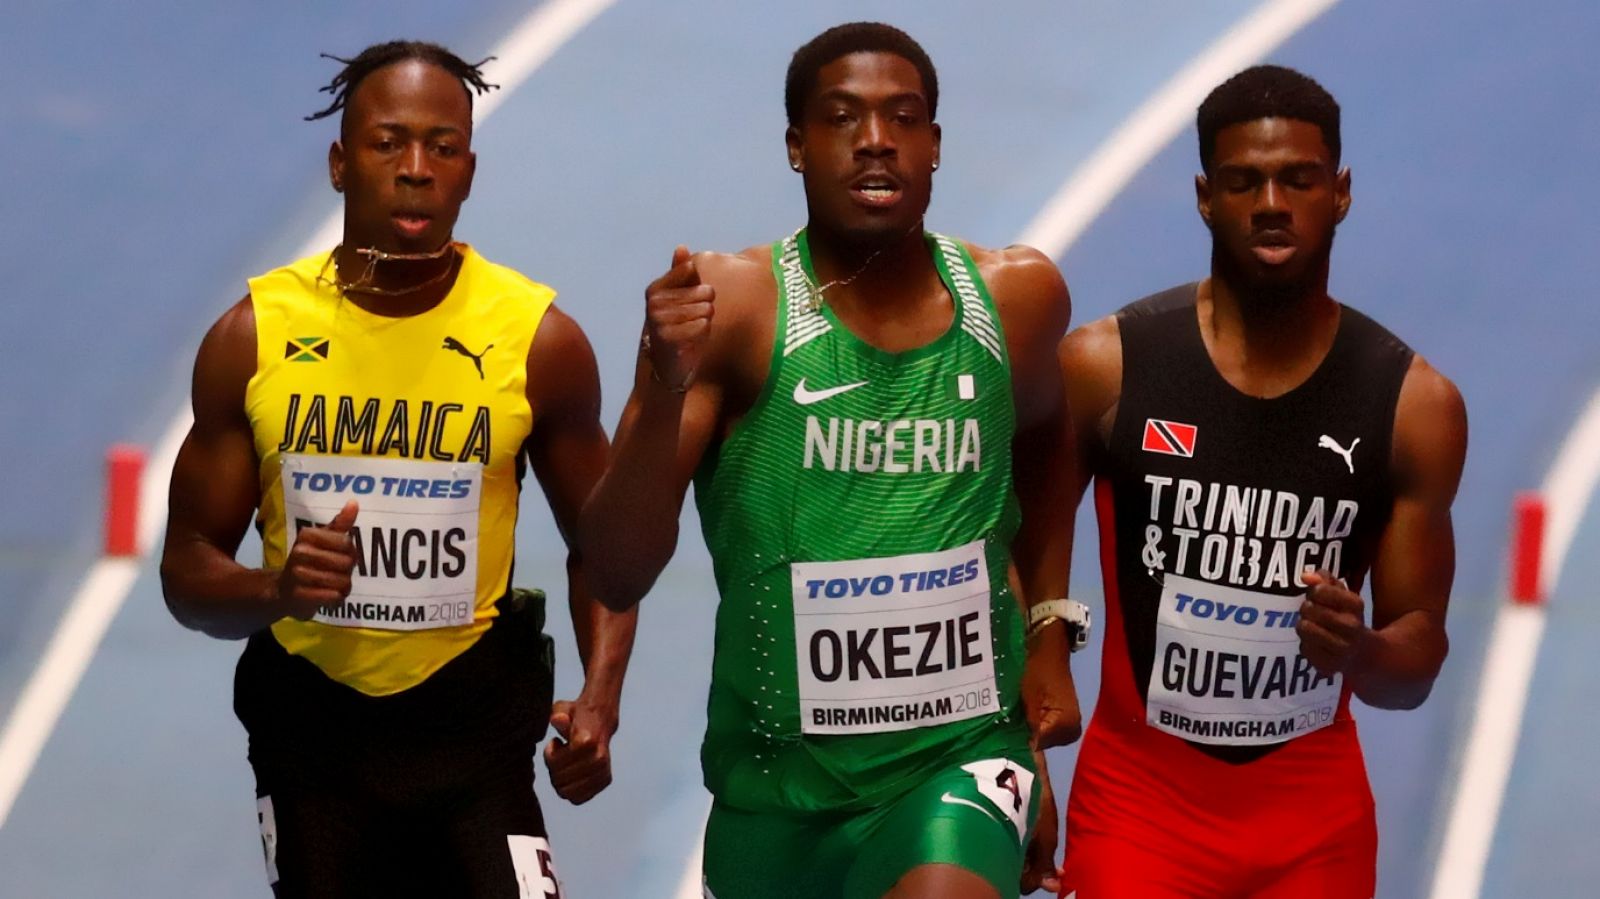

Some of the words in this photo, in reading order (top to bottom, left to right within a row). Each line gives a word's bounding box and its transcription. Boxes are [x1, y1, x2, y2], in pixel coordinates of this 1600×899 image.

[279, 394, 490, 465] JAMAICA
[803, 416, 981, 472] NIGERIA
[292, 472, 375, 495] TOYO
[381, 478, 472, 499] TIRES
[1145, 475, 1359, 540] TRINIDAD
[296, 518, 466, 580] ANCIS
[806, 575, 894, 599] TOYO
[900, 559, 979, 592] TIRES
[318, 602, 425, 622] MINGHAM
[428, 601, 469, 622] 2018
[1175, 593, 1259, 625] TOYO
[809, 611, 983, 682] OKEZIE
[813, 697, 952, 726] BIRMINGHAM
[955, 688, 992, 713] 2018
[1159, 710, 1294, 737] BIRMINGHAM
[1297, 706, 1332, 731] 2018
[996, 767, 1023, 813] 4
